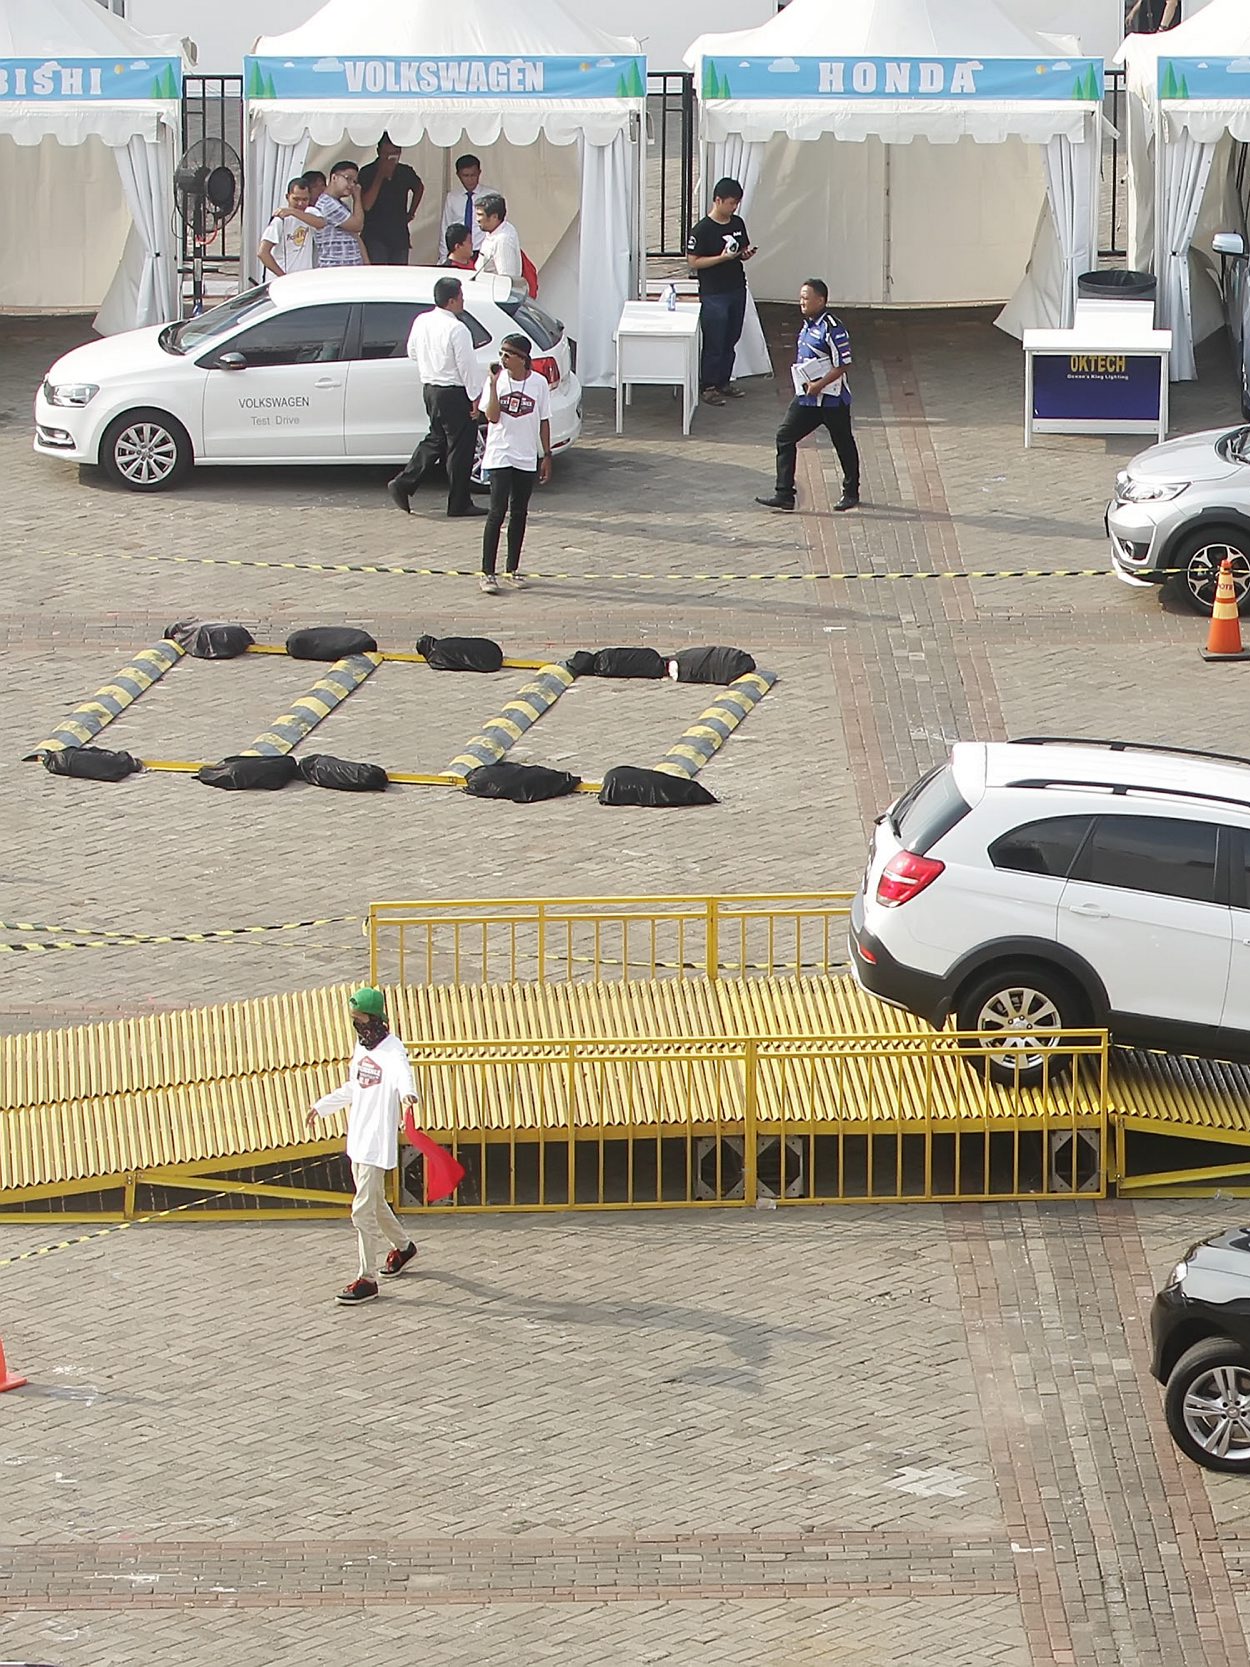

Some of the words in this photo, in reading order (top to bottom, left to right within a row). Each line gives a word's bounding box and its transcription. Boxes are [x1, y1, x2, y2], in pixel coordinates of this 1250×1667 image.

[344, 60, 544, 93] VOLKSWAGEN
[818, 62, 976, 93] HONDA
[1070, 355, 1126, 372] OKTECH
[238, 396, 310, 409] VOLKSWAGEN
[251, 416, 270, 426] Test
[275, 415, 300, 425] Drive
